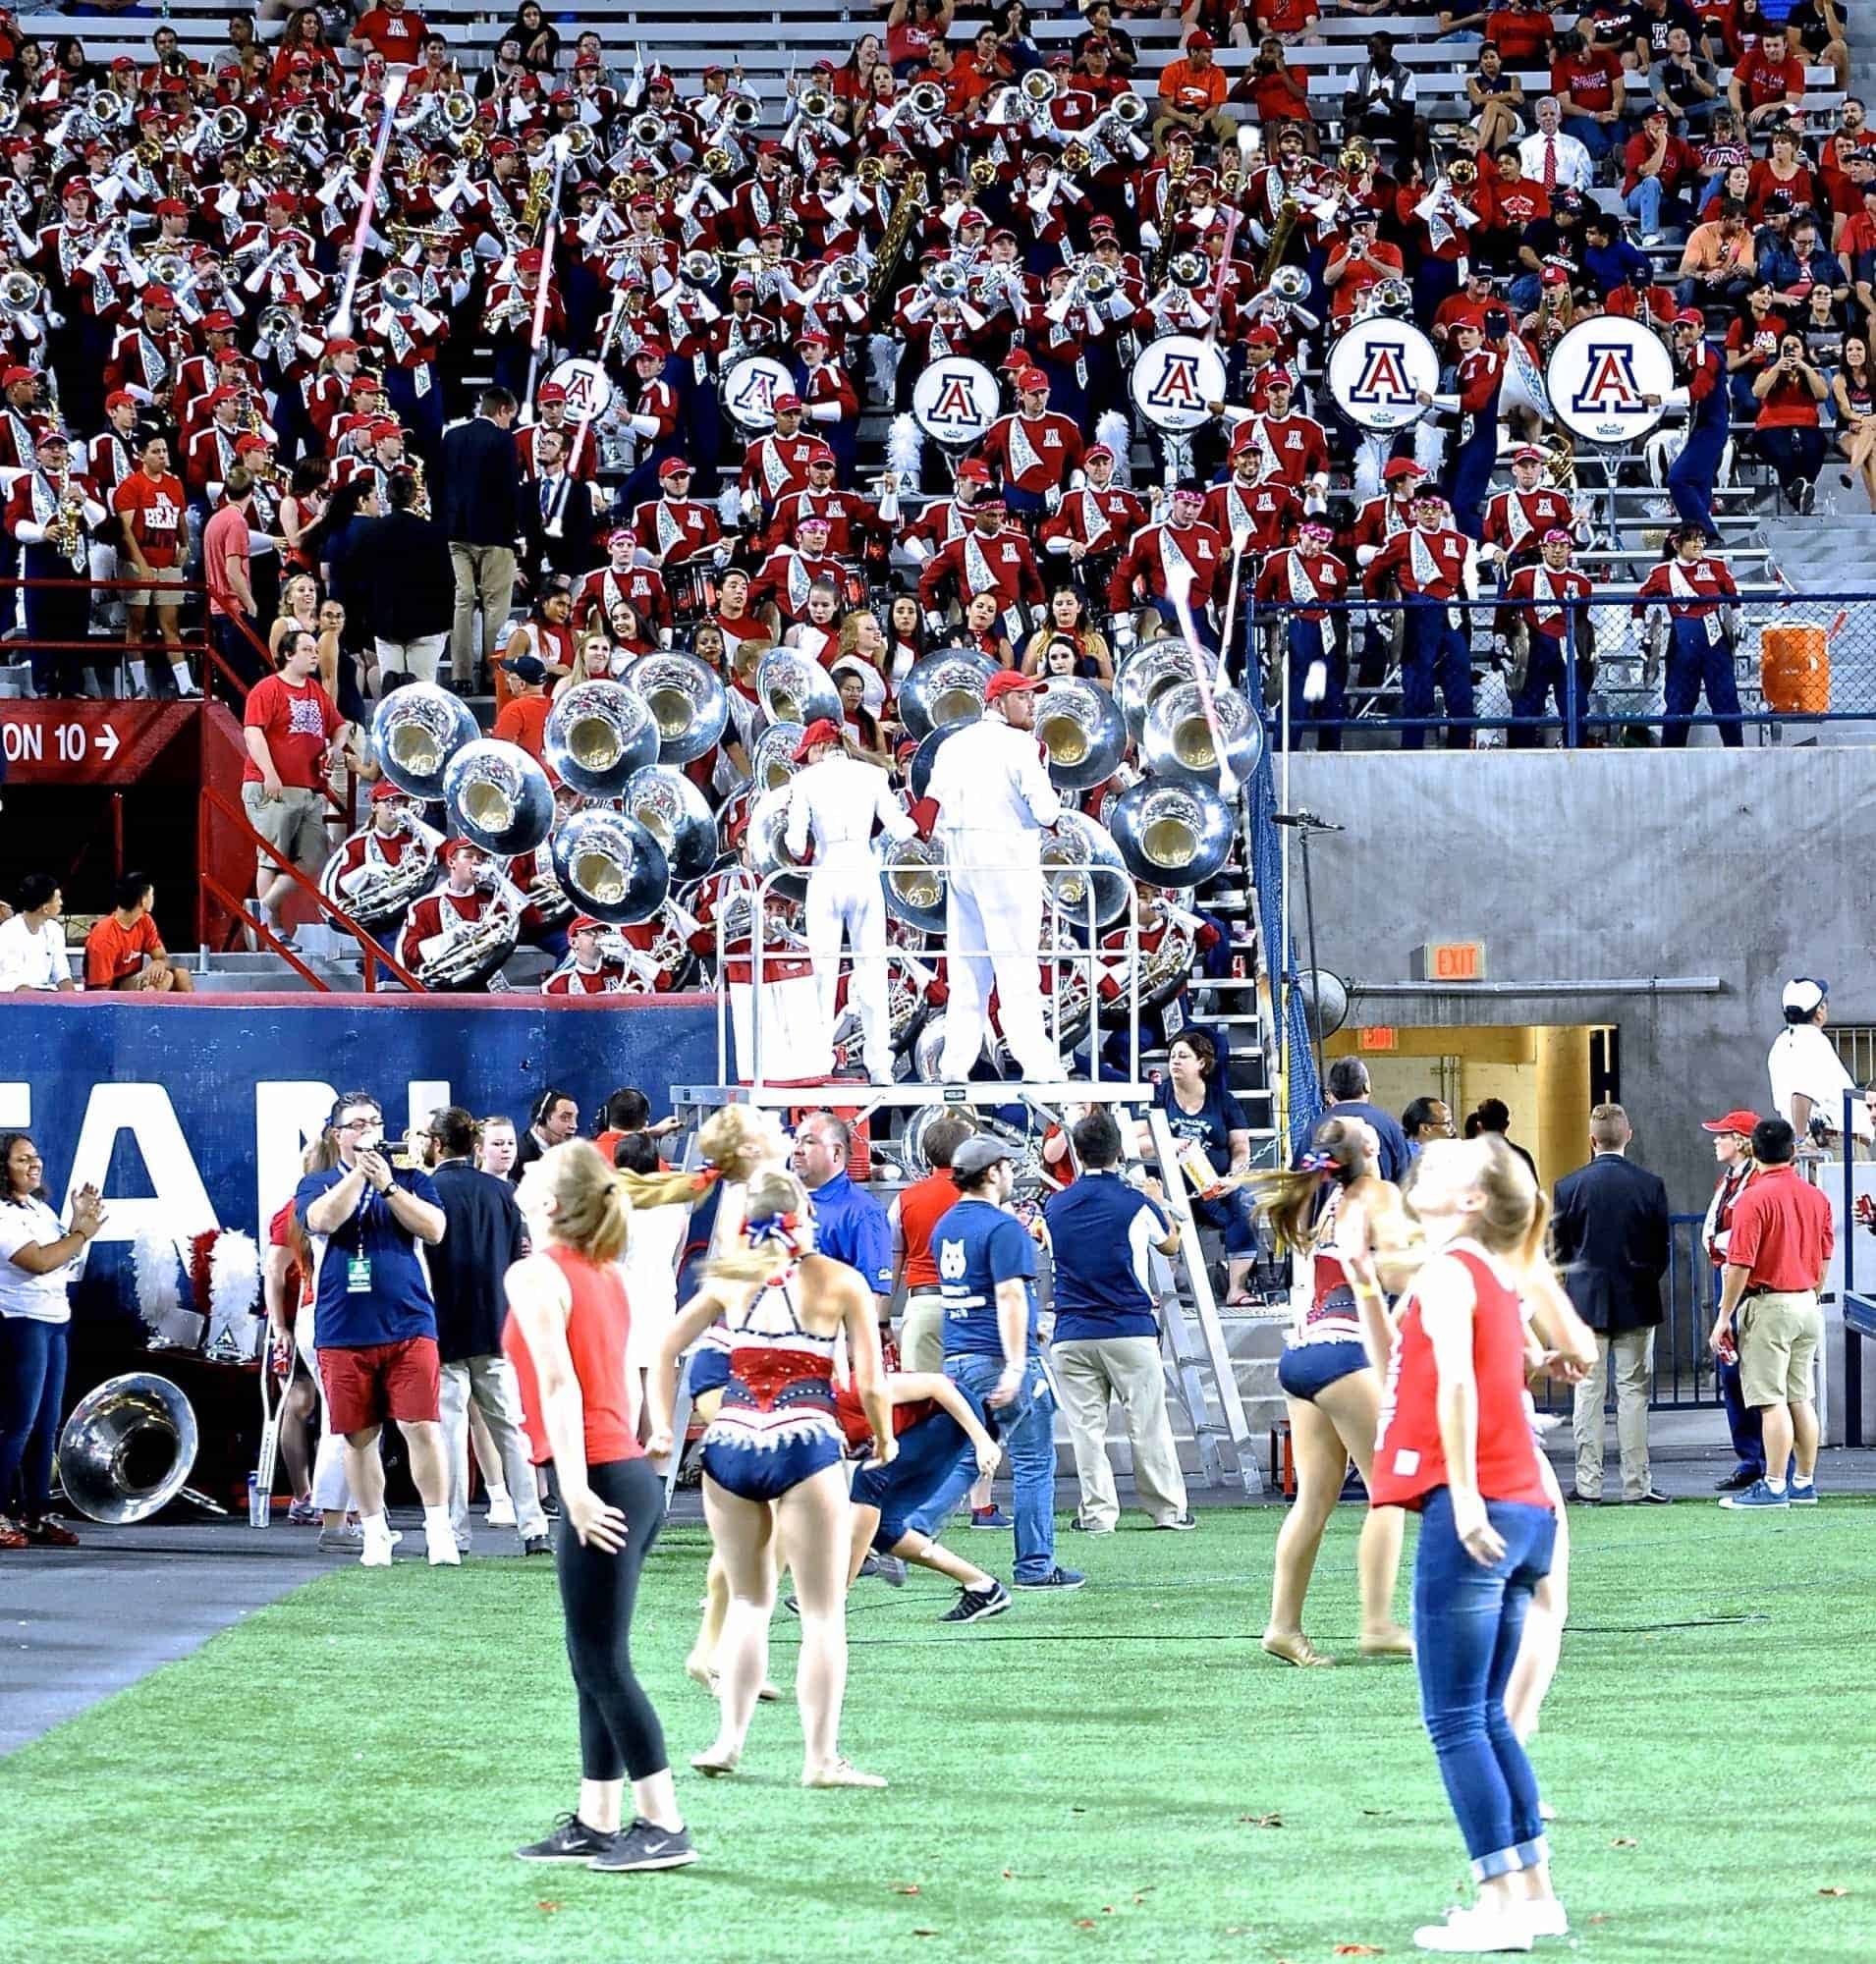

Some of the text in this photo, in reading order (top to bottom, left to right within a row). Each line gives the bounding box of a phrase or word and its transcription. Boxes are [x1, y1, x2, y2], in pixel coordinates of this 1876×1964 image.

[387, 18, 409, 37] A
[565, 368, 596, 412] A
[734, 367, 779, 416] A
[1147, 354, 1206, 411] A
[1350, 342, 1416, 404] A
[1573, 344, 1649, 413] A
[928, 373, 981, 426] A
[2, 722, 86, 761] ON 10
[1437, 947, 1477, 976] EXIT
